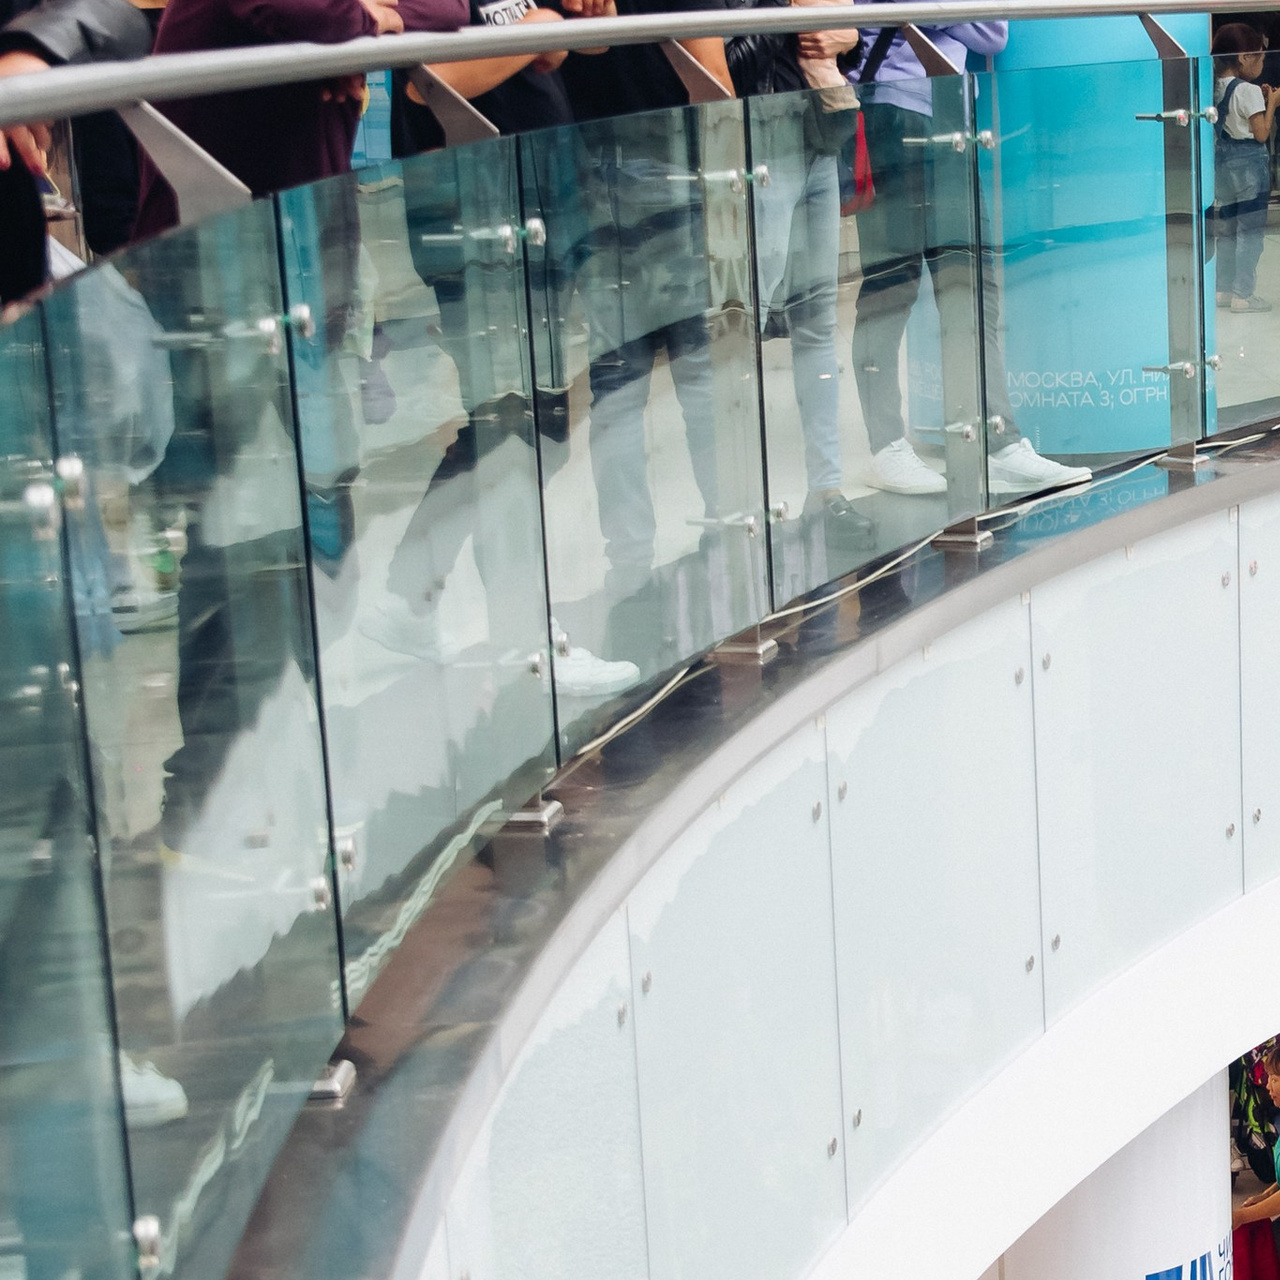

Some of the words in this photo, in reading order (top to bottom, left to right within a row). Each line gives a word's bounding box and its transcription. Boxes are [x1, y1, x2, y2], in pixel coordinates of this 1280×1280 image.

[1007, 370, 1103, 390] МОСКВА,
[1107, 369, 1137, 386] УЛ.
[1009, 391, 1095, 408] ОМНАТА
[1119, 386, 1168, 406] ОГРН
